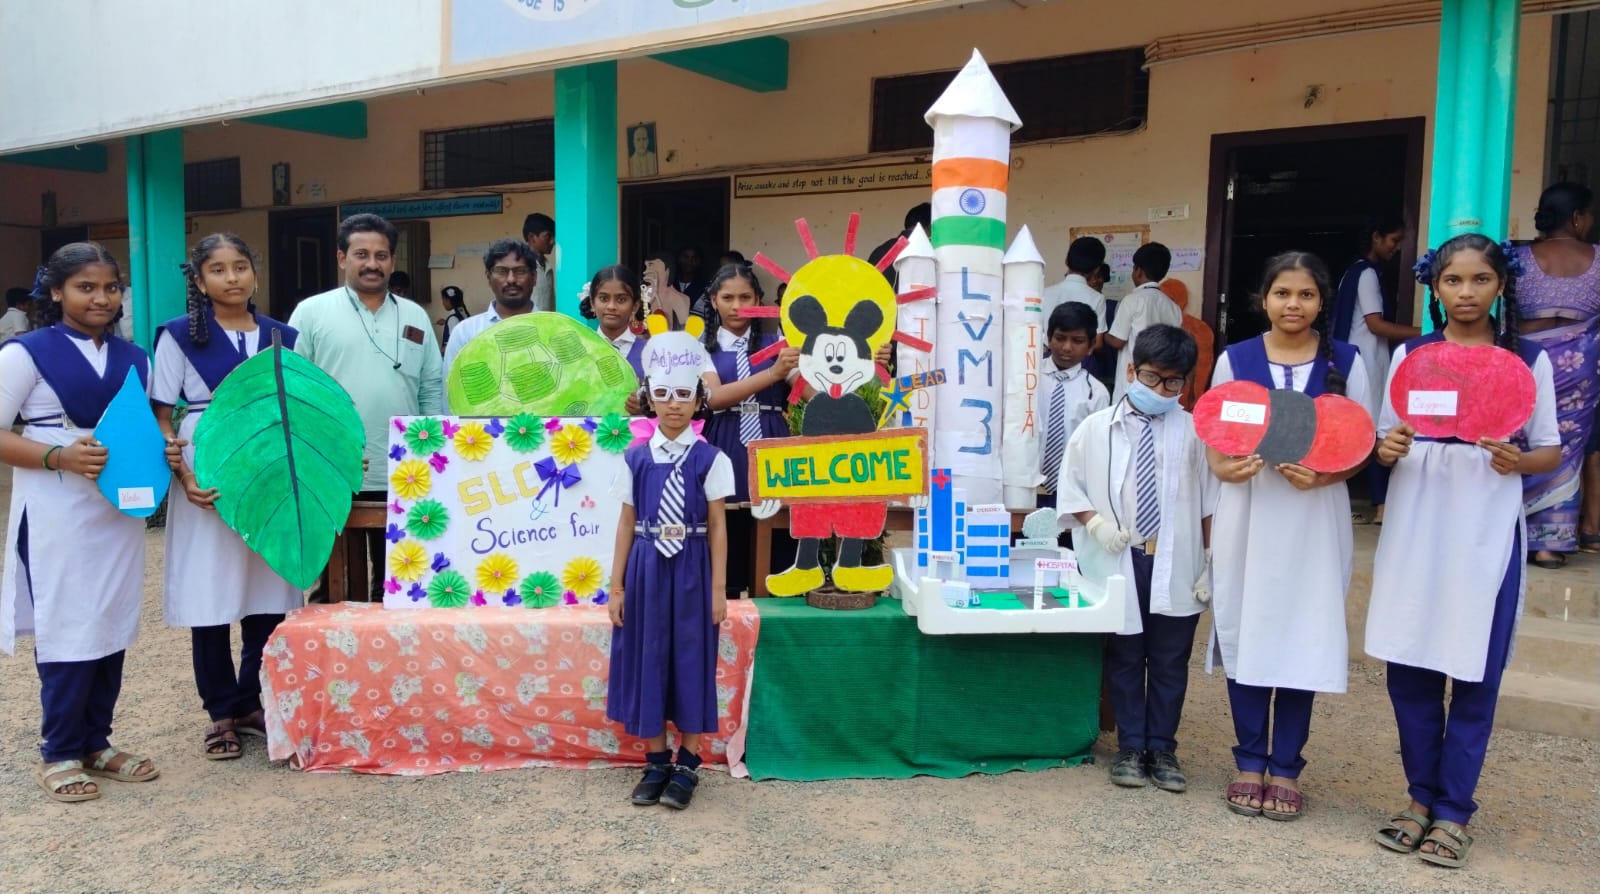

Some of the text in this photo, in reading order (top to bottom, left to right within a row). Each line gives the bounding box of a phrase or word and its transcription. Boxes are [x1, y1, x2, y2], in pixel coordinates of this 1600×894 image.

[811, 177, 825, 186] not
[828, 176, 838, 185] till
[842, 175, 855, 184] the
[858, 173, 876, 188] goal
[879, 172, 886, 182] is
[898, 369, 946, 391] LEAD
[1021, 325, 1038, 437] INDIA
[765, 449, 911, 487] WELCOME
[457, 461, 540, 516] SLC
[471, 512, 600, 554] Science fair
[1043, 561, 1077, 570] HOSPITAL
